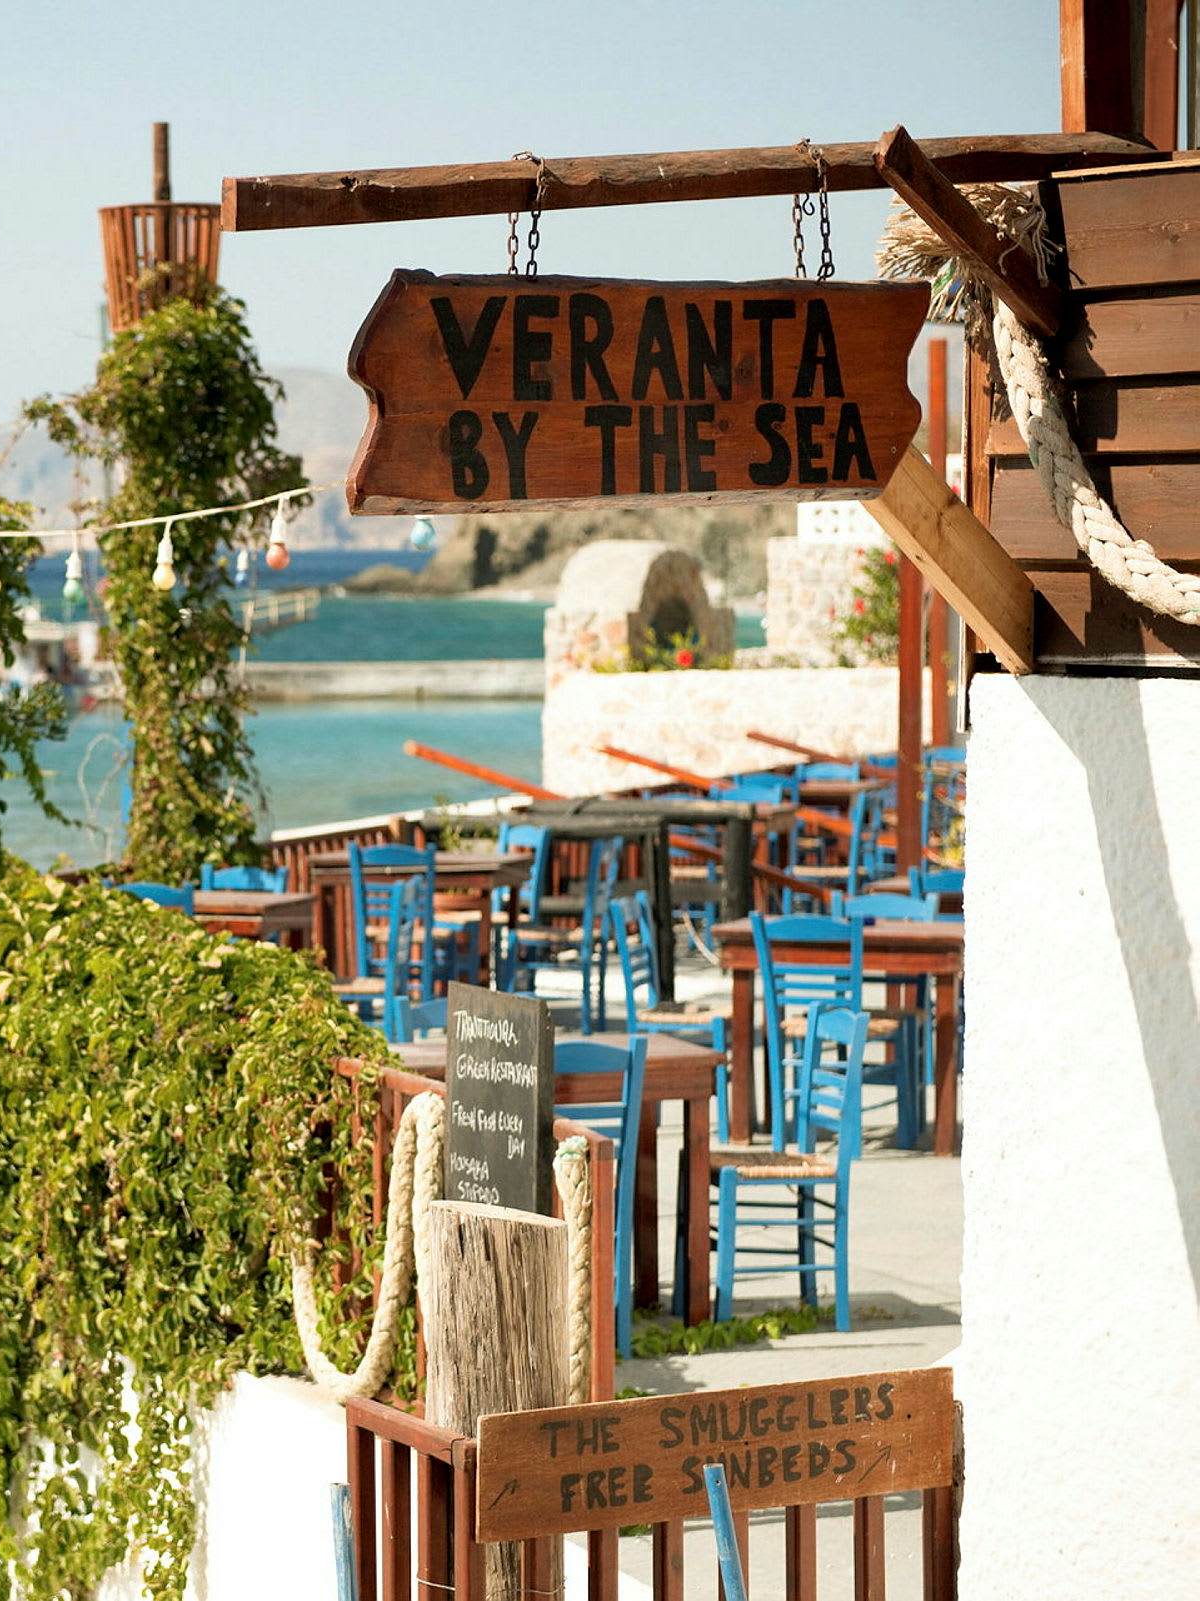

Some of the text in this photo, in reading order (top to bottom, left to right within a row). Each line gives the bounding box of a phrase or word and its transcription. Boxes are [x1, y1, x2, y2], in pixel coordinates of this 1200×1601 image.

[430, 292, 844, 401] VERANTA
[448, 402, 877, 500] BY THE SEA
[507, 1134, 525, 1159] DAY
[540, 1382, 895, 1459] THE SMUGGLERS
[560, 1464, 654, 1514] FREE
